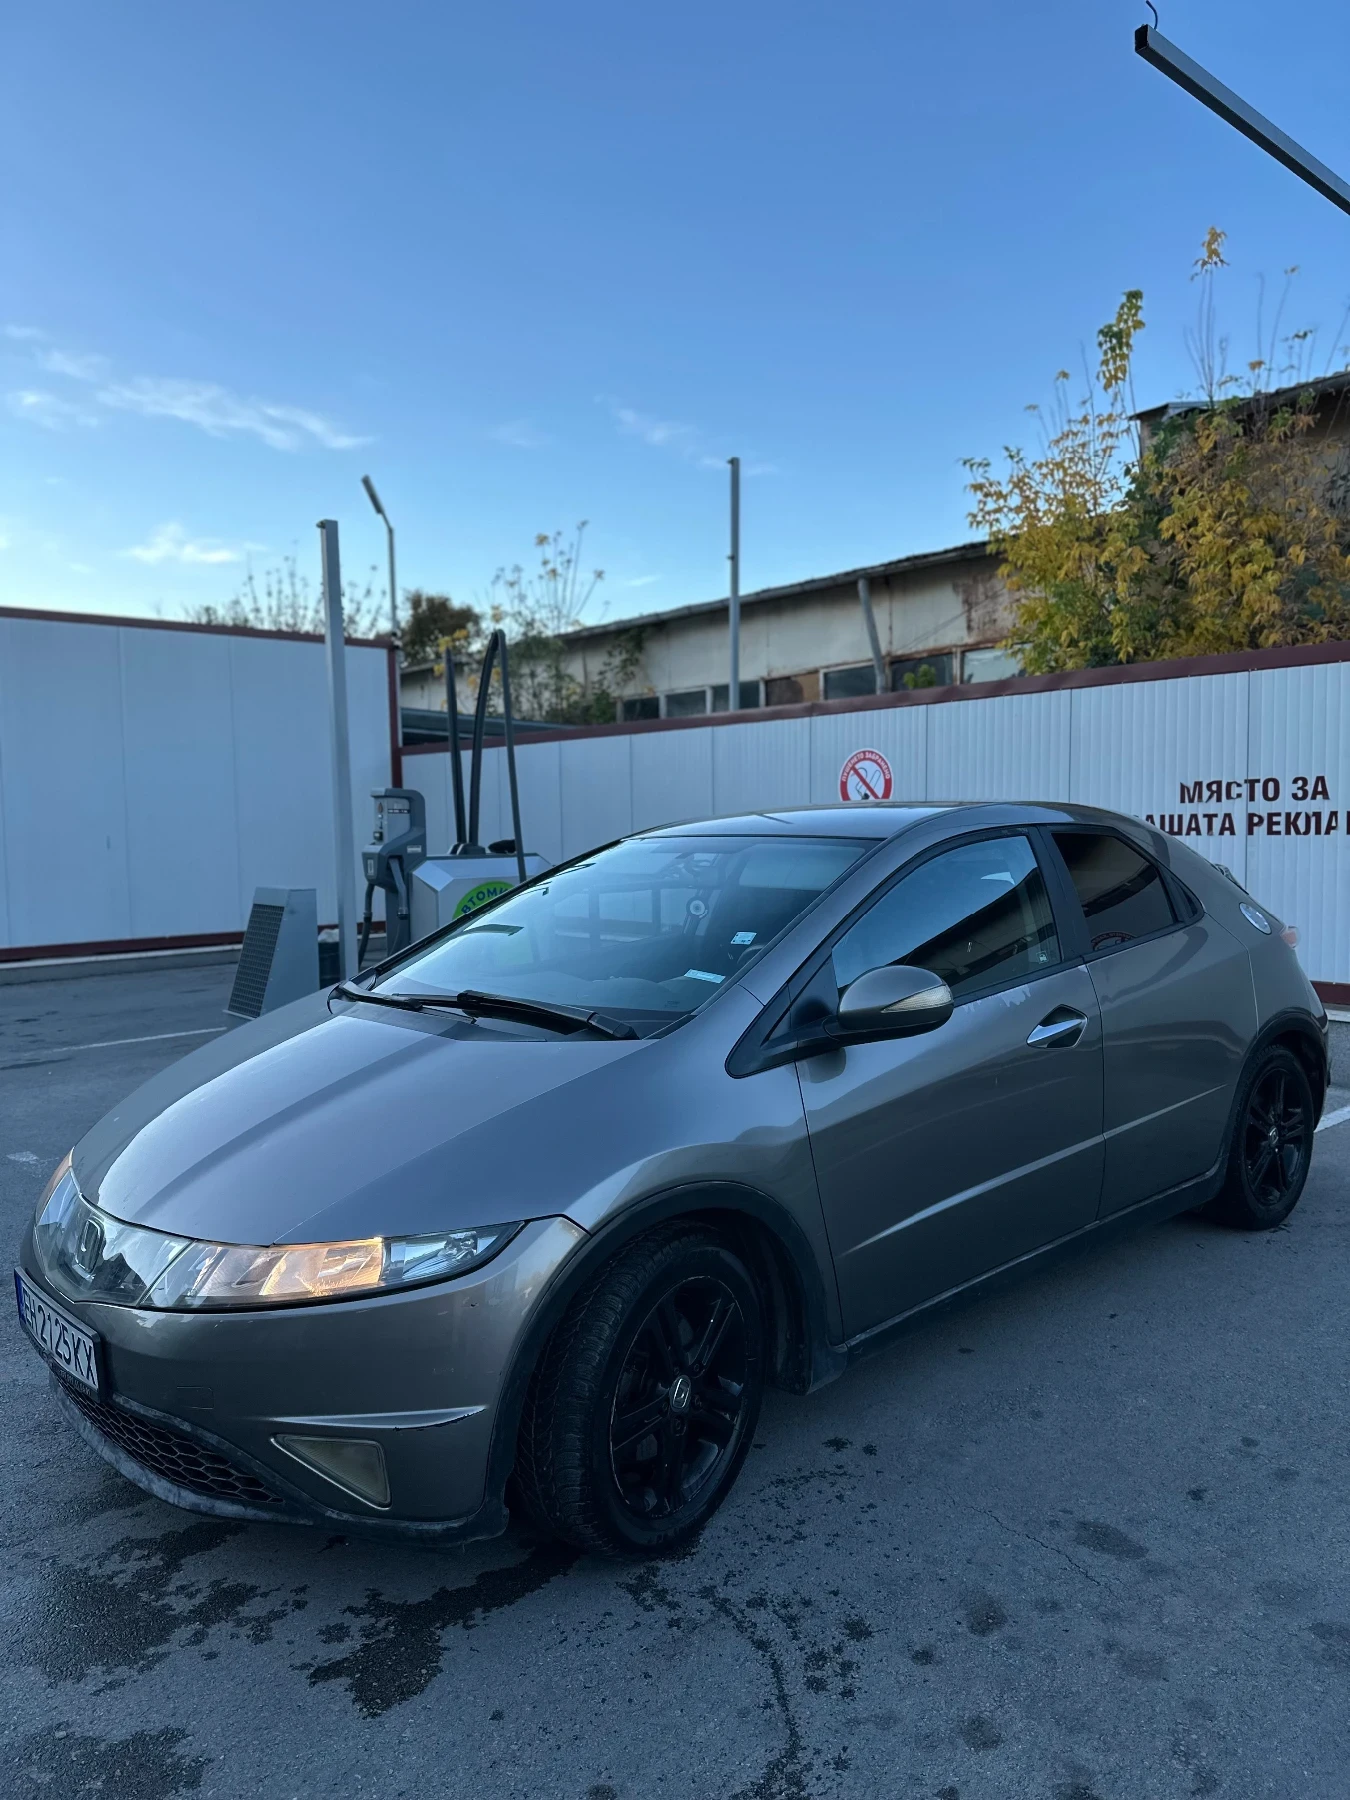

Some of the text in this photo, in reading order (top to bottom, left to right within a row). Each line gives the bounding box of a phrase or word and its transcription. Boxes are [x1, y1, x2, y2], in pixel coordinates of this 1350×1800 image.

[841, 751, 891, 782] ПУШЕНЕТО ЗАБРАНЕНО
[1179, 775, 1330, 803] МЯСТО ЗА
[1247, 810, 1350, 836] РЕКЛА
